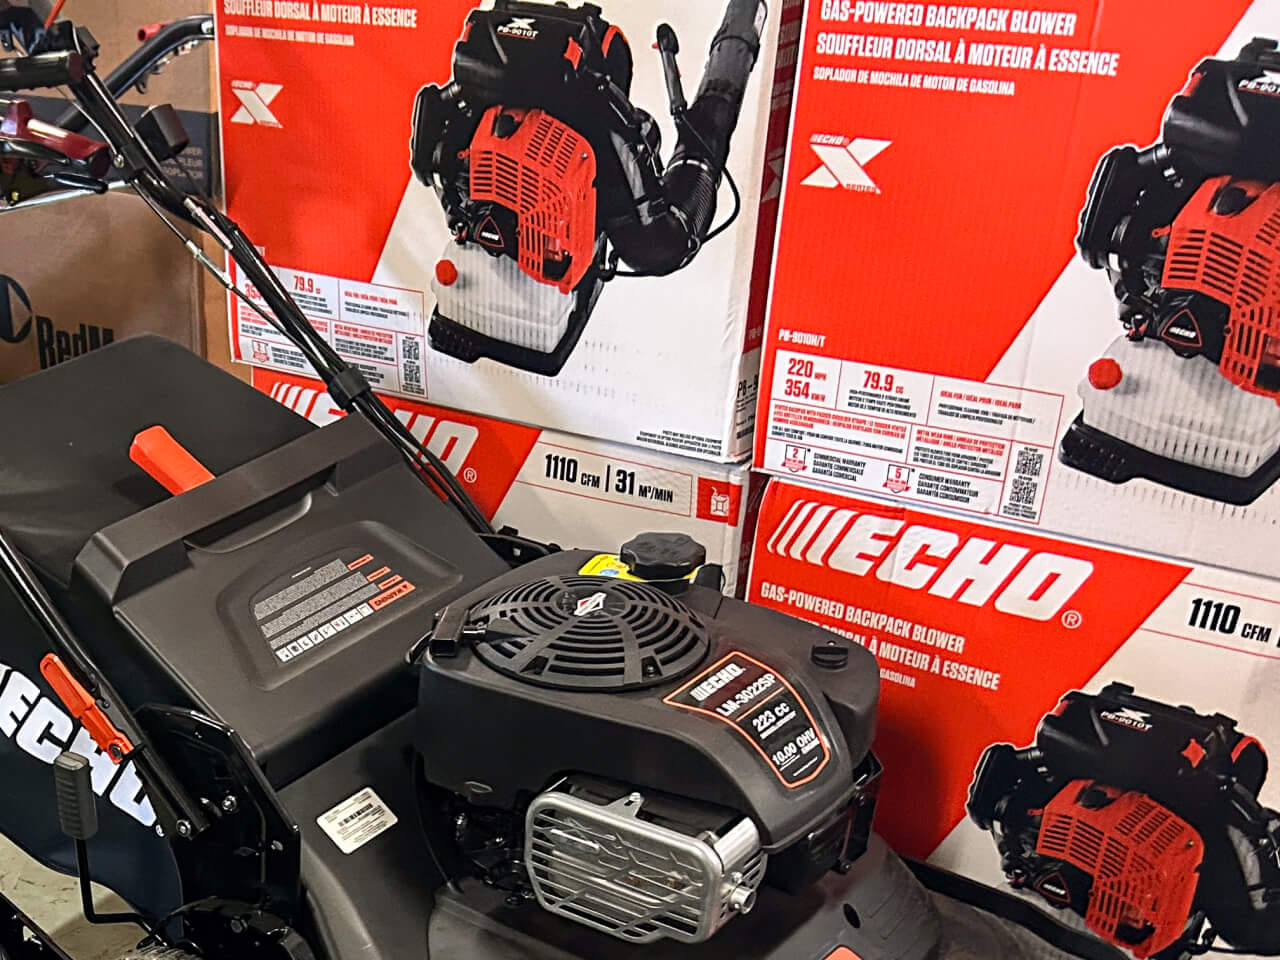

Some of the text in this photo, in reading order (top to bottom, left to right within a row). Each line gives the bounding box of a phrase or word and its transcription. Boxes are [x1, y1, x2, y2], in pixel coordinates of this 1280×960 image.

[274, 2, 310, 20] DORSAL
[312, 1, 320, 21] À
[321, 4, 361, 24] MOTEUR
[363, 3, 370, 24] À
[372, 7, 417, 28] ESSENCE
[820, 0, 1077, 36] GAS-POWERED BACKPACK BLOWER
[816, 32, 1120, 77] SOUFFLEUR DORSAL À MOTEUR À ESSENCE
[813, 66, 1015, 96] SOPLADOR DE MOCHILA DE MOTOR DE GASOLINA
[293, 275, 314, 292] 79.9
[787, 358, 814, 378] 220
[863, 370, 894, 392] 79.9
[784, 379, 810, 399] 354
[544, 453, 577, 484] 1110
[580, 473, 601, 490] CFM
[615, 469, 635, 496] 31
[795, 506, 1095, 621] ECHO
[760, 581, 966, 654] GAS-POWERED BACKPACK BLOWER
[1187, 597, 1273, 643] 1110 CFM
[696, 661, 744, 699] ECHO
[878, 642, 930, 670] MOTEUR
[930, 653, 941, 674] À
[942, 660, 1001, 691] ESSENCE
[716, 671, 777, 717] LM-3022SP
[751, 709, 777, 732] 223
[773, 701, 790, 717] cc
[771, 728, 816, 766] 10.00 OHV
